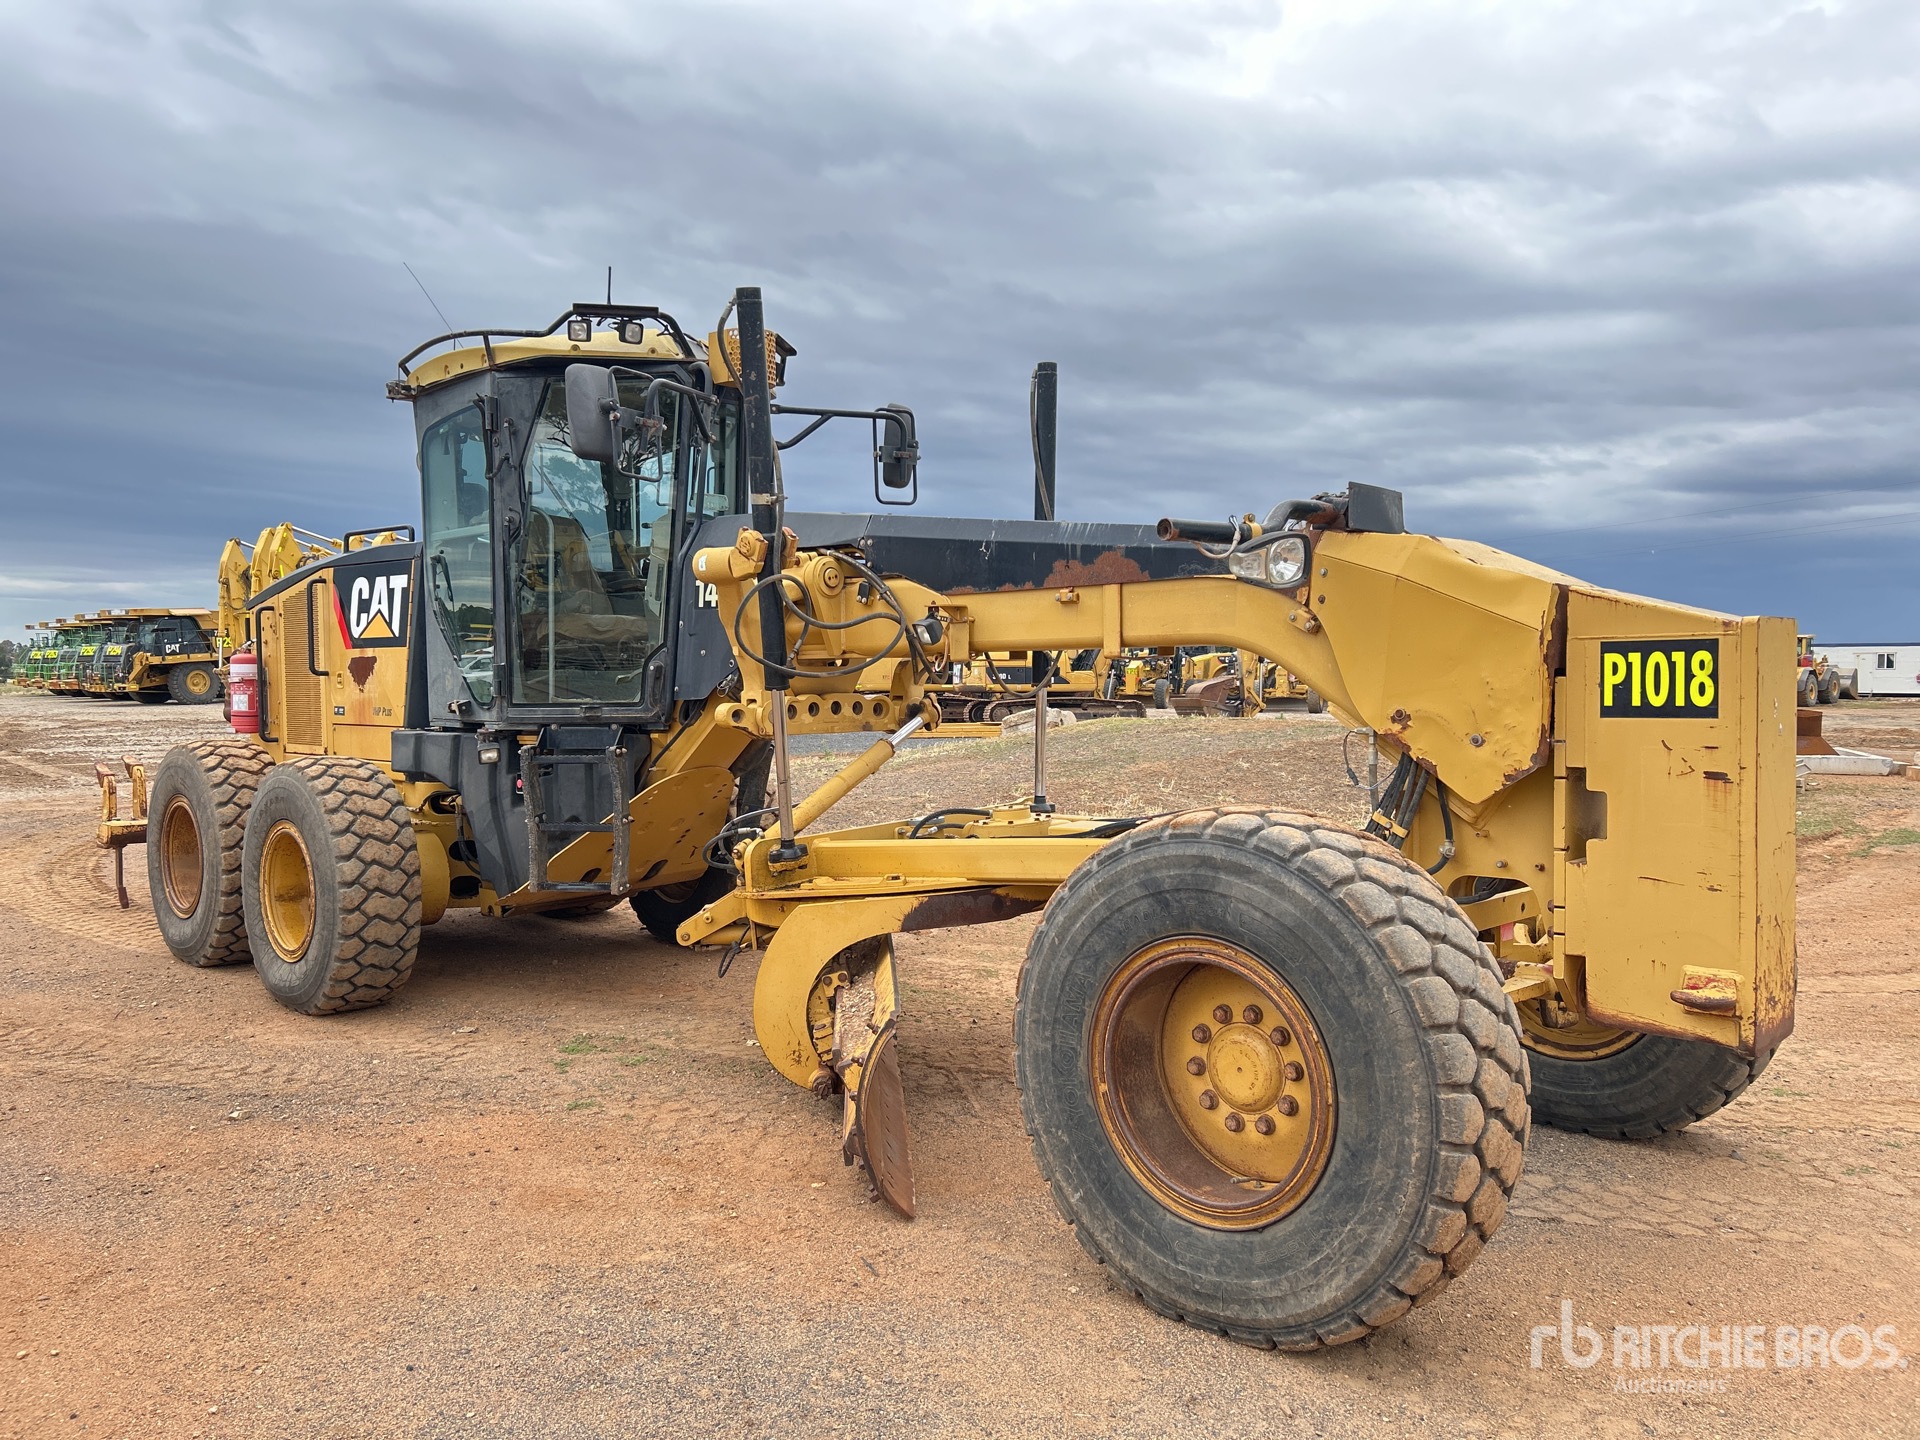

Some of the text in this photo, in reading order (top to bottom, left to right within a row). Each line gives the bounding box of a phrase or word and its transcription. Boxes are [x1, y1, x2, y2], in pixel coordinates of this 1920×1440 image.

[350, 574, 408, 638] CAT
[165, 644, 180, 653] CAT
[1603, 650, 1715, 707] P1018
[1058, 972, 1094, 1126] YOKOHAMA
